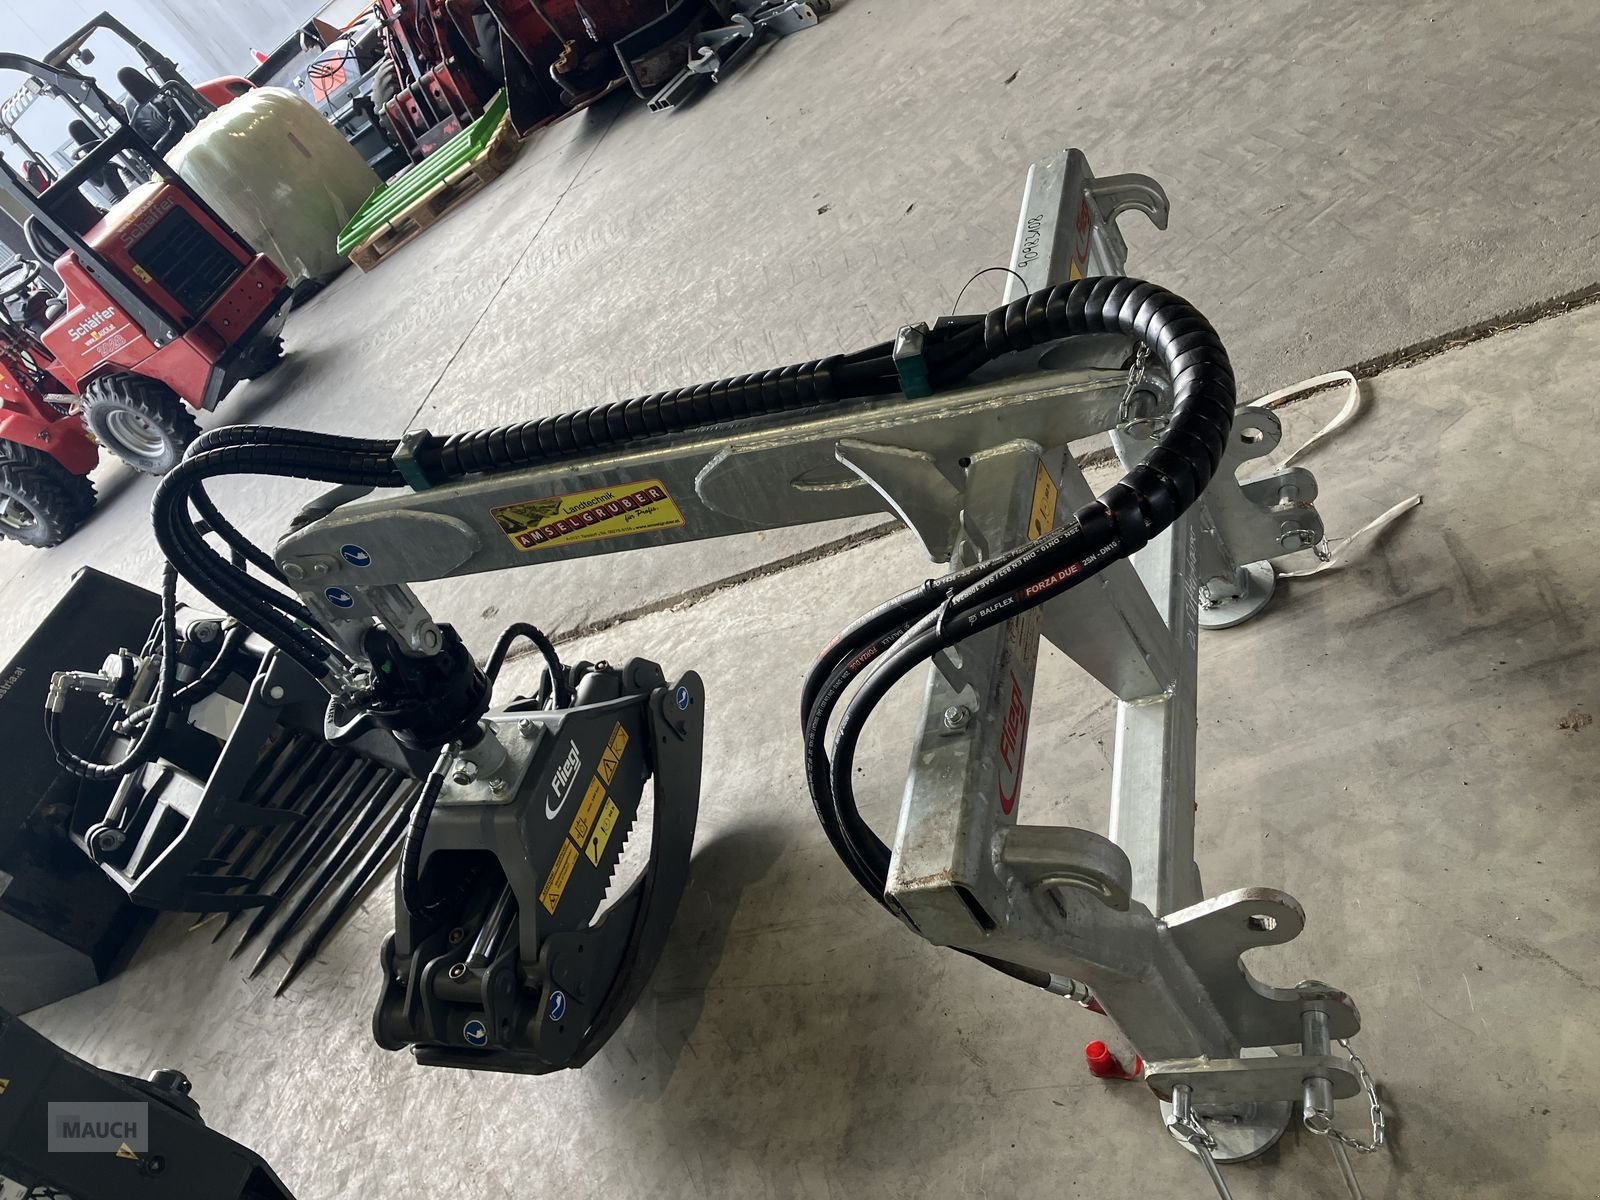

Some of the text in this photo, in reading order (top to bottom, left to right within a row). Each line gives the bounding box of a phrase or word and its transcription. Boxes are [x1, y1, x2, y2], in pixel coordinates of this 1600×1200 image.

[68, 306, 115, 342] Schäffer
[562, 492, 615, 515] Landtechnik
[519, 488, 662, 546] AMSELGRUBER
[1064, 527, 1080, 538] 2SN
[1040, 538, 1060, 552] DN10
[1011, 560, 1023, 570] EN
[1022, 551, 1036, 563] DIN
[979, 542, 1118, 617] BALFLEX FORZA DUE 2SN DN10
[980, 576, 995, 589] SAE
[1000, 669, 1026, 775] Fliegl
[551, 739, 582, 798] Fliegl
